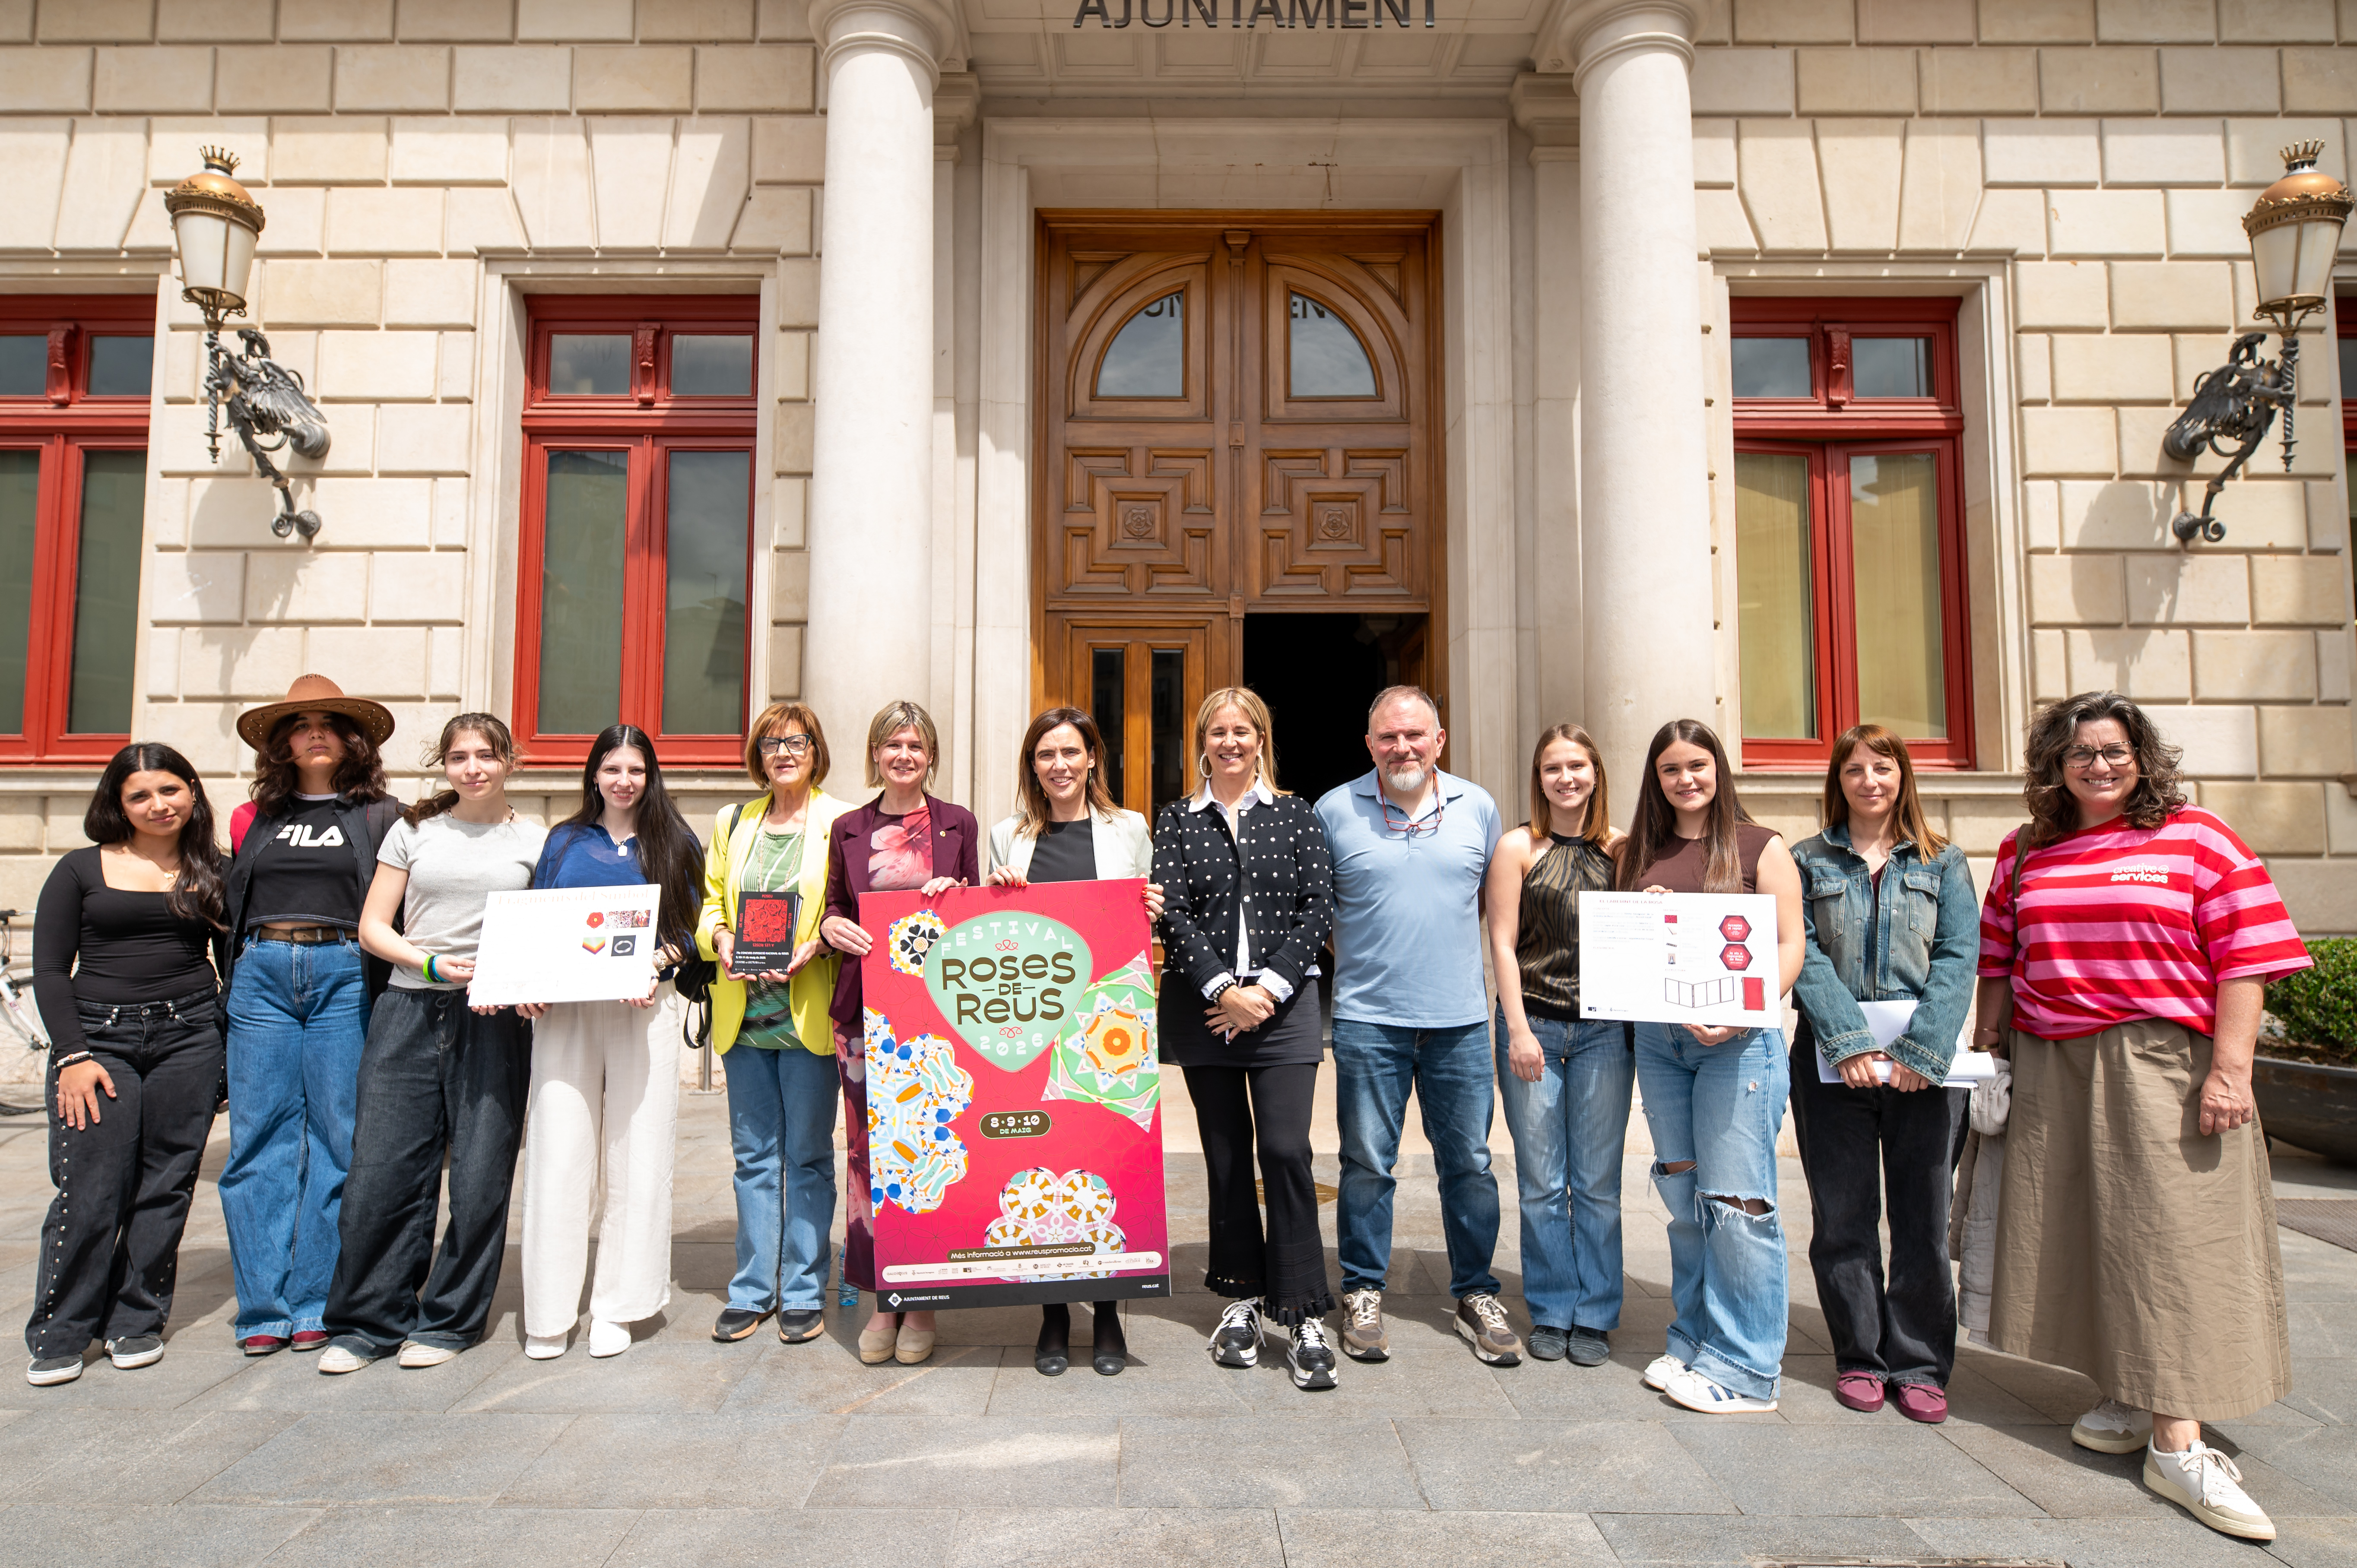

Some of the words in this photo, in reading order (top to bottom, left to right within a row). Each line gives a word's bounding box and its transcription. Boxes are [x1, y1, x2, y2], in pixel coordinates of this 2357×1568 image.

[276, 824, 344, 847] FILA
[2113, 863, 2157, 874] creative
[2111, 871, 2168, 884] services
[941, 920, 1073, 957] FESTIVAL
[998, 982, 1022, 996] DE
[979, 1033, 1044, 1056] 2026
[967, 1249, 1004, 1258] informació
[1012, 1245, 1092, 1256] www.reuspromocio.cat
